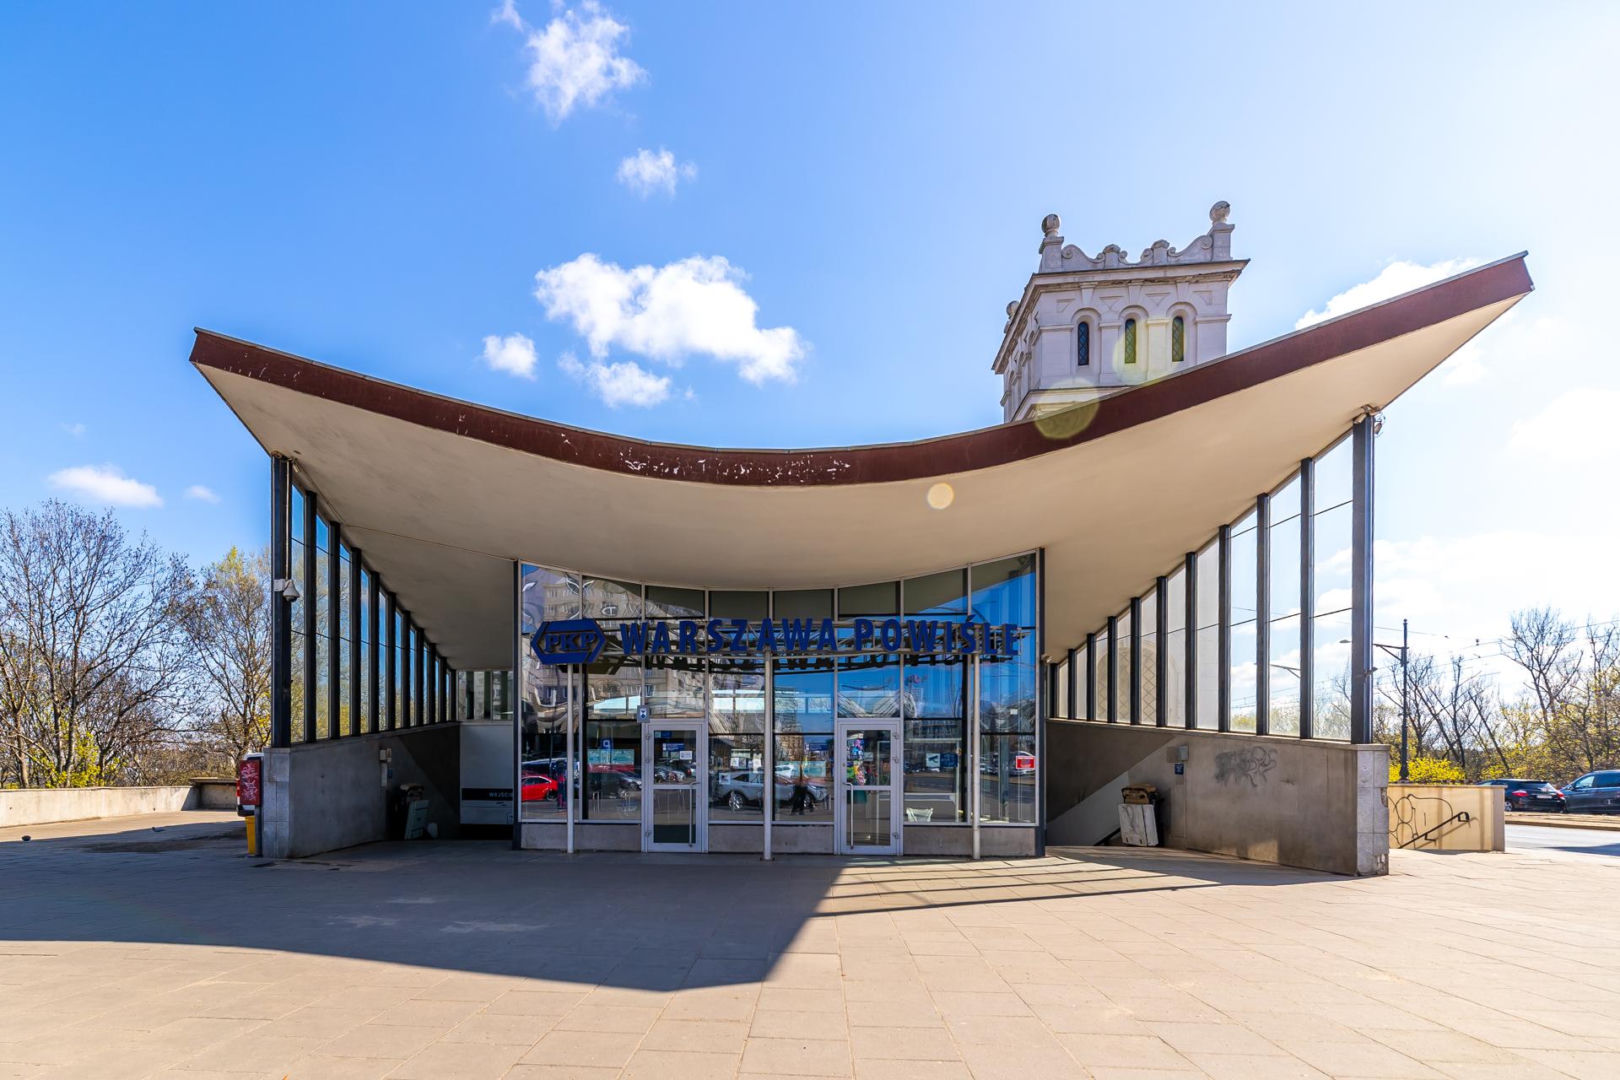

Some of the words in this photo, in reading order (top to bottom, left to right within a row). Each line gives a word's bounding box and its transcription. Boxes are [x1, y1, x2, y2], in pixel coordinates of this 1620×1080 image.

[544, 633, 596, 651] PKP
[620, 617, 838, 655] WARSZAWA
[854, 615, 1018, 655] POWIŚLE
